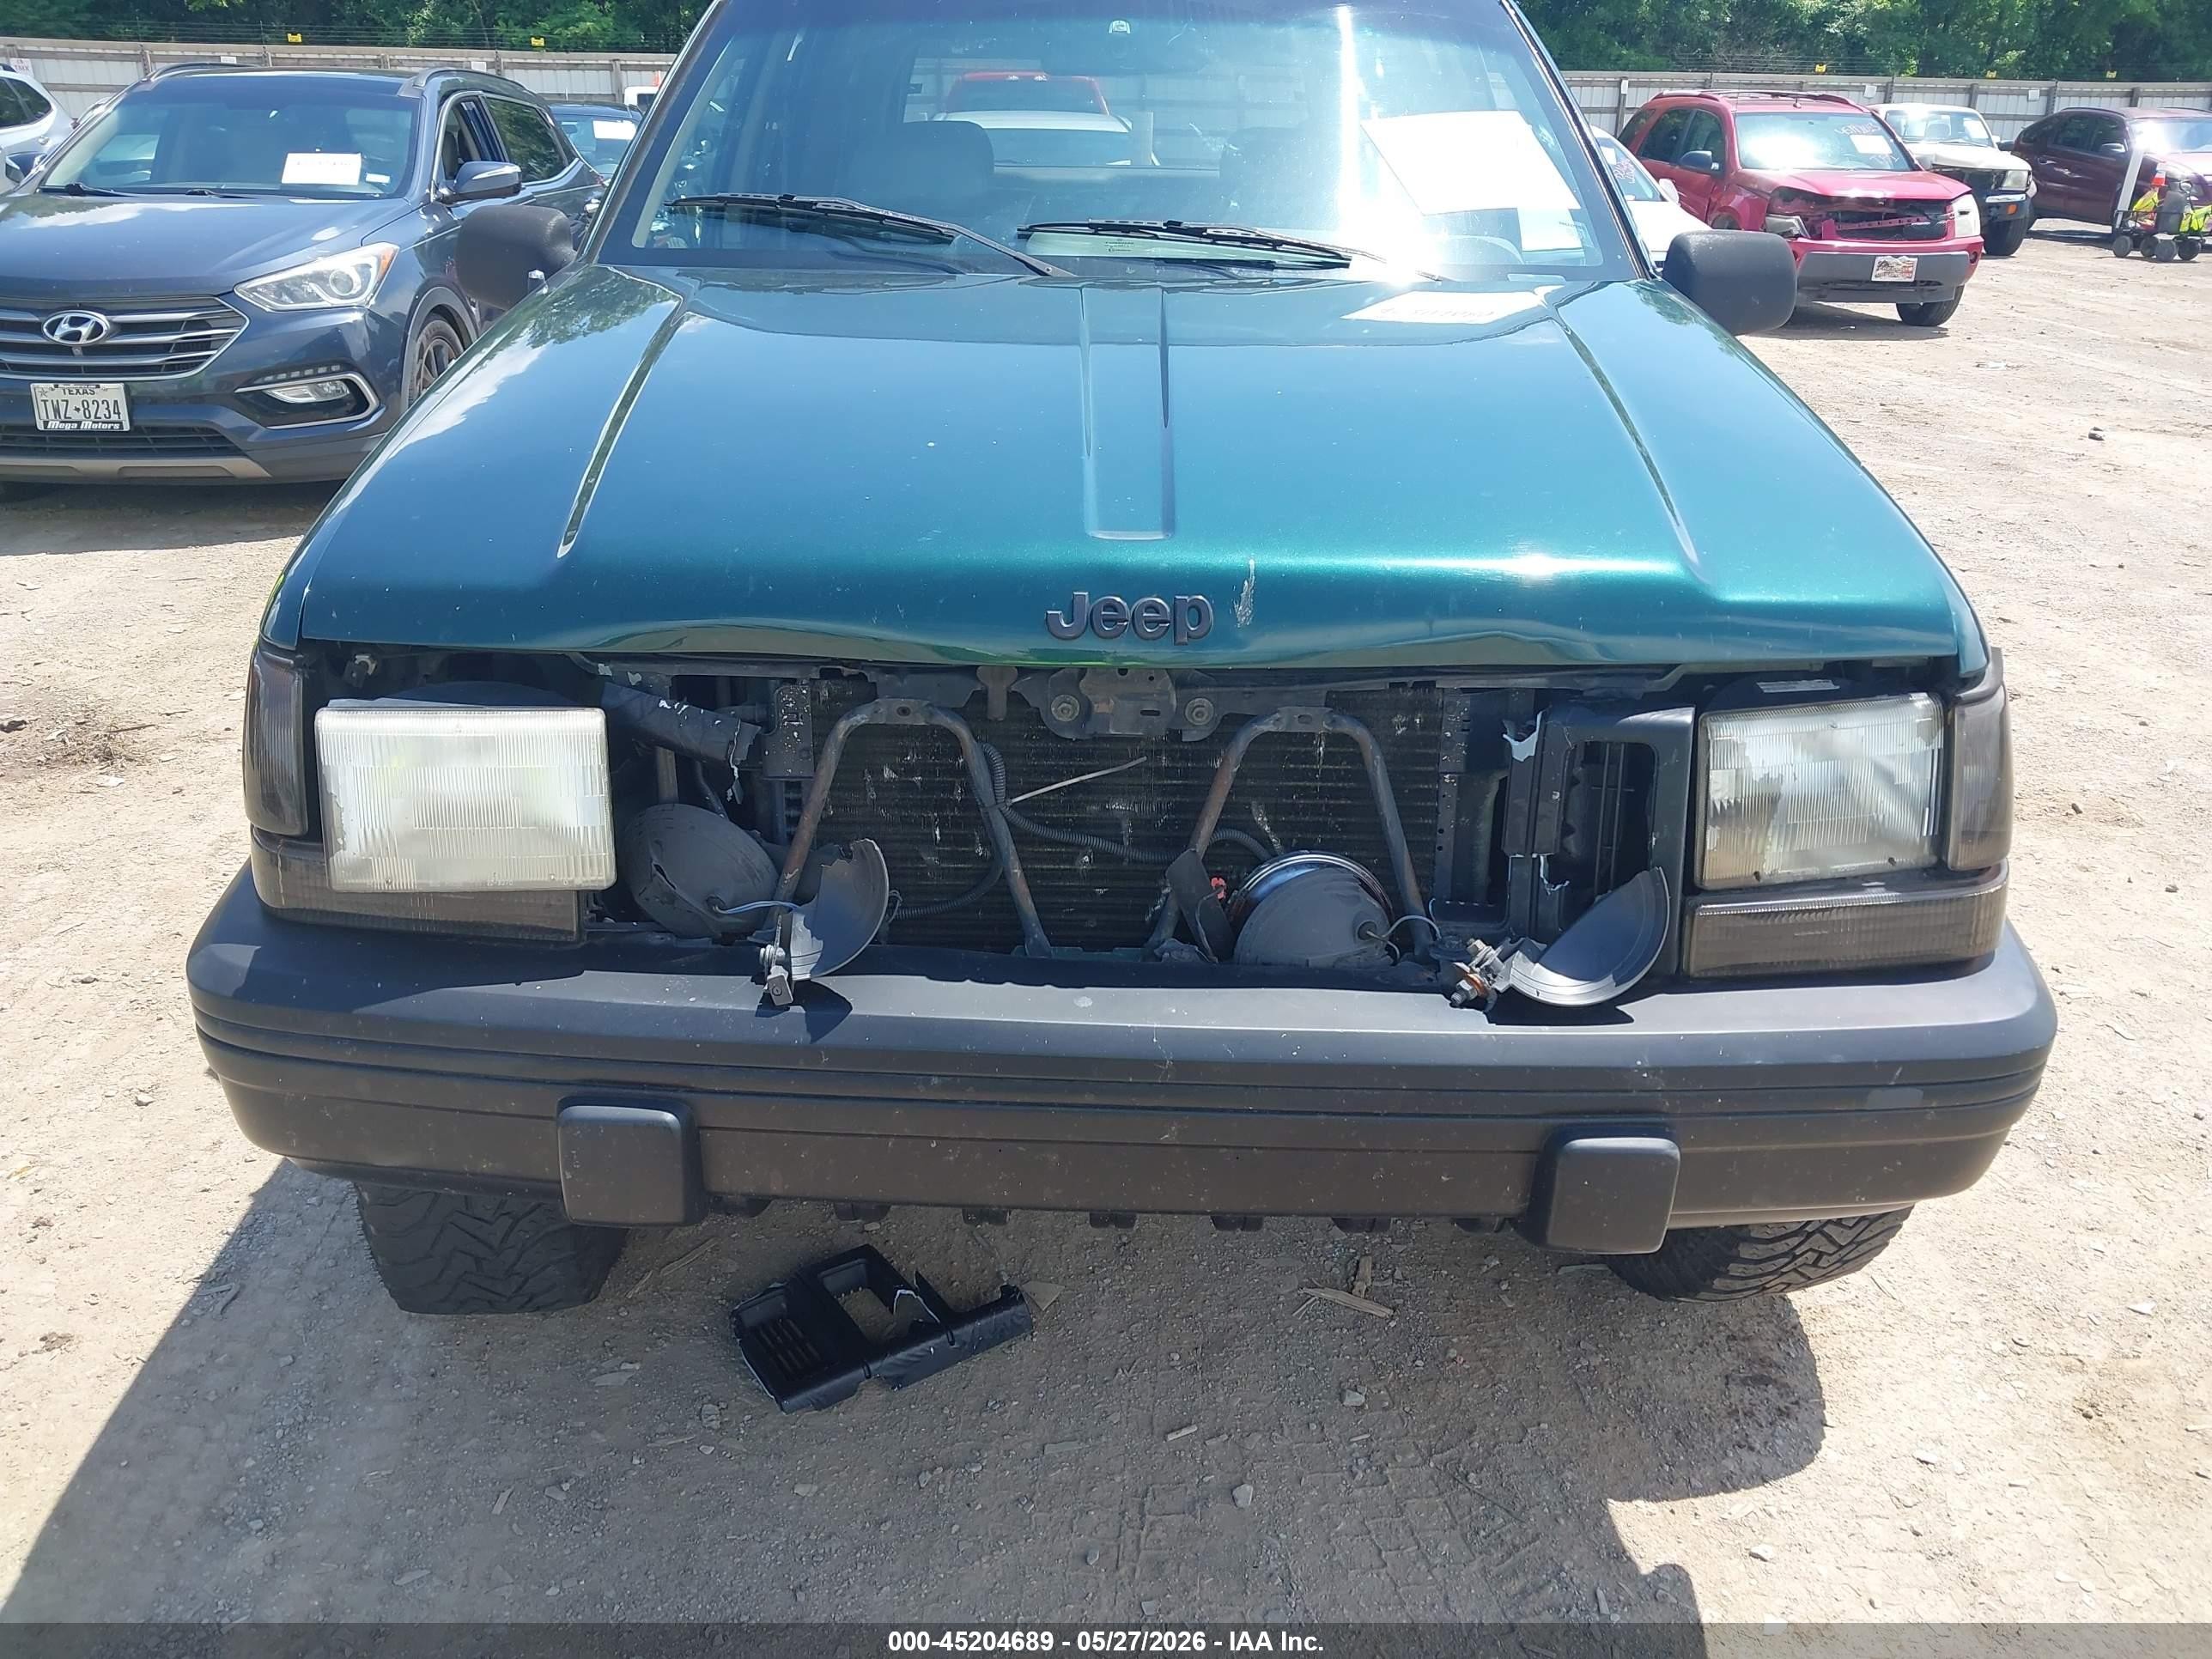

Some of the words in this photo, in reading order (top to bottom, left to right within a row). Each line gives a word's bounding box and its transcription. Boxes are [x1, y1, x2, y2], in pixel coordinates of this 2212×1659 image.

[82, 398, 121, 420] 8234
[46, 421, 78, 430] Mega
[80, 421, 120, 430] Motors
[1045, 591, 1213, 645] Jeep
